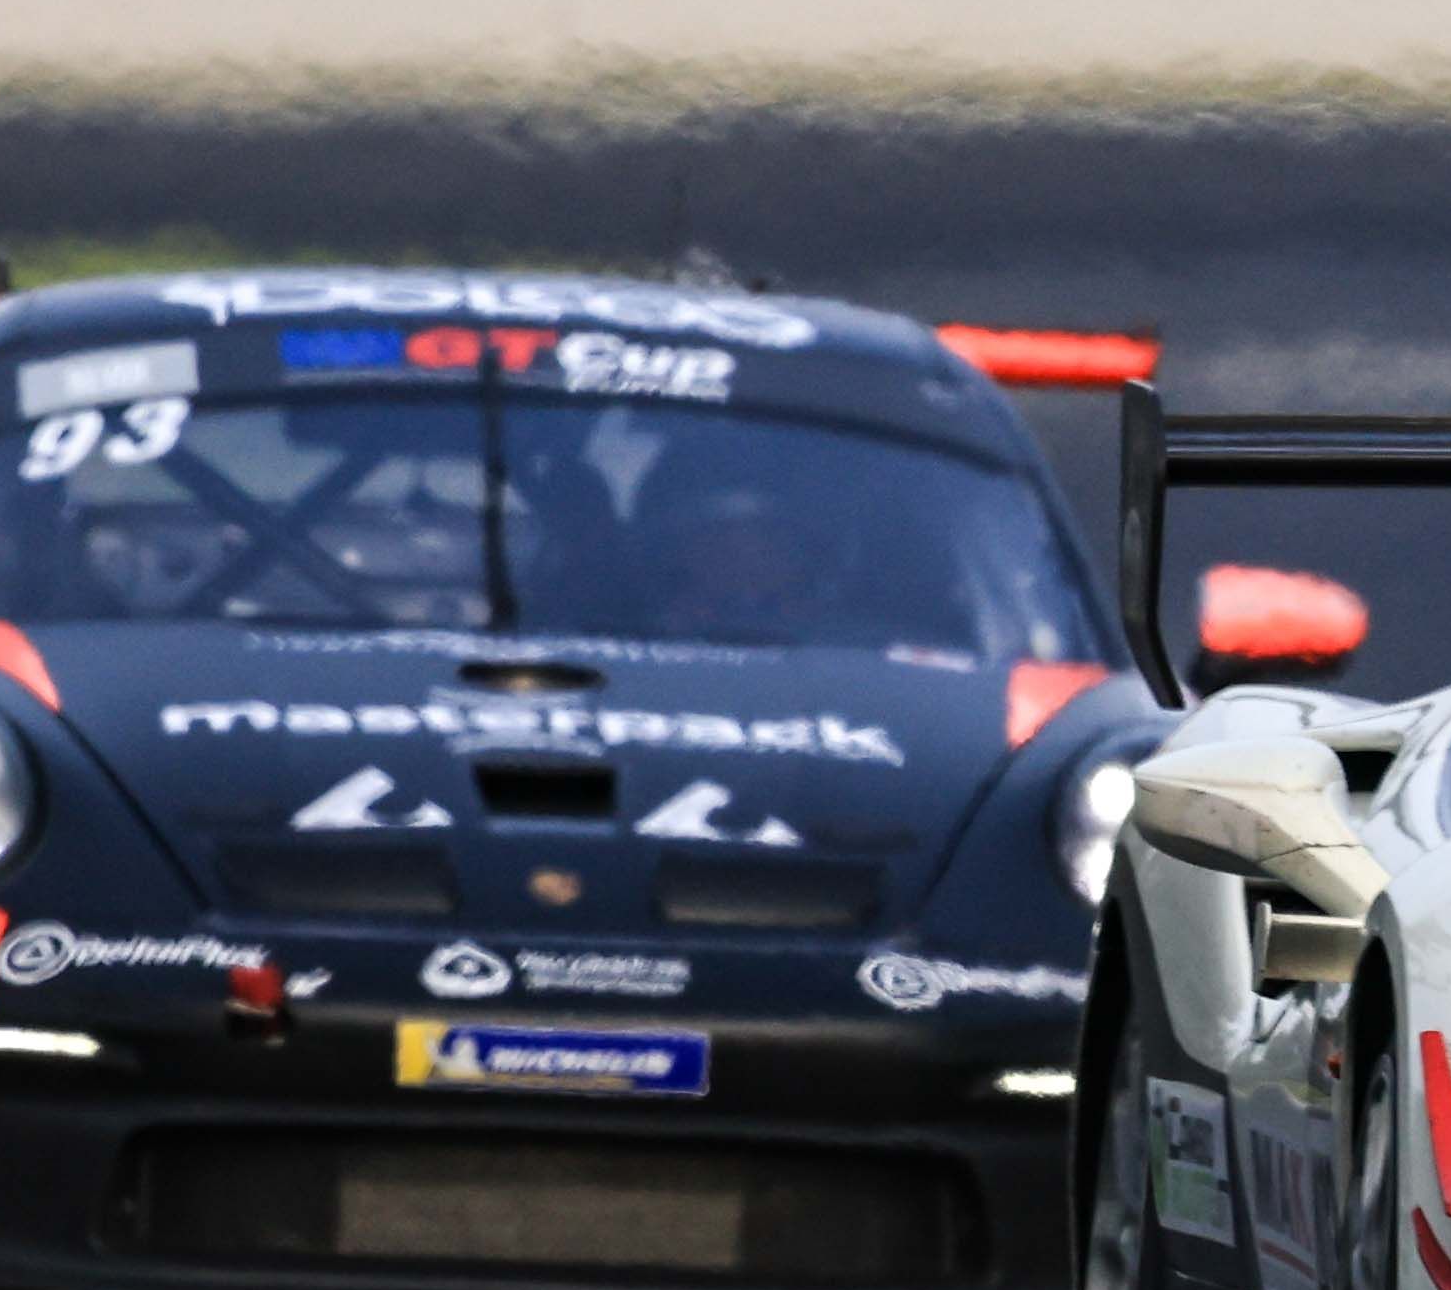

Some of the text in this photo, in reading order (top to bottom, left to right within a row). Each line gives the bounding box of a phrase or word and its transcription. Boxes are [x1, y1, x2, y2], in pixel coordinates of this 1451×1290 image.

[405, 326, 736, 390] GT Cup
[17, 395, 190, 482] 93
